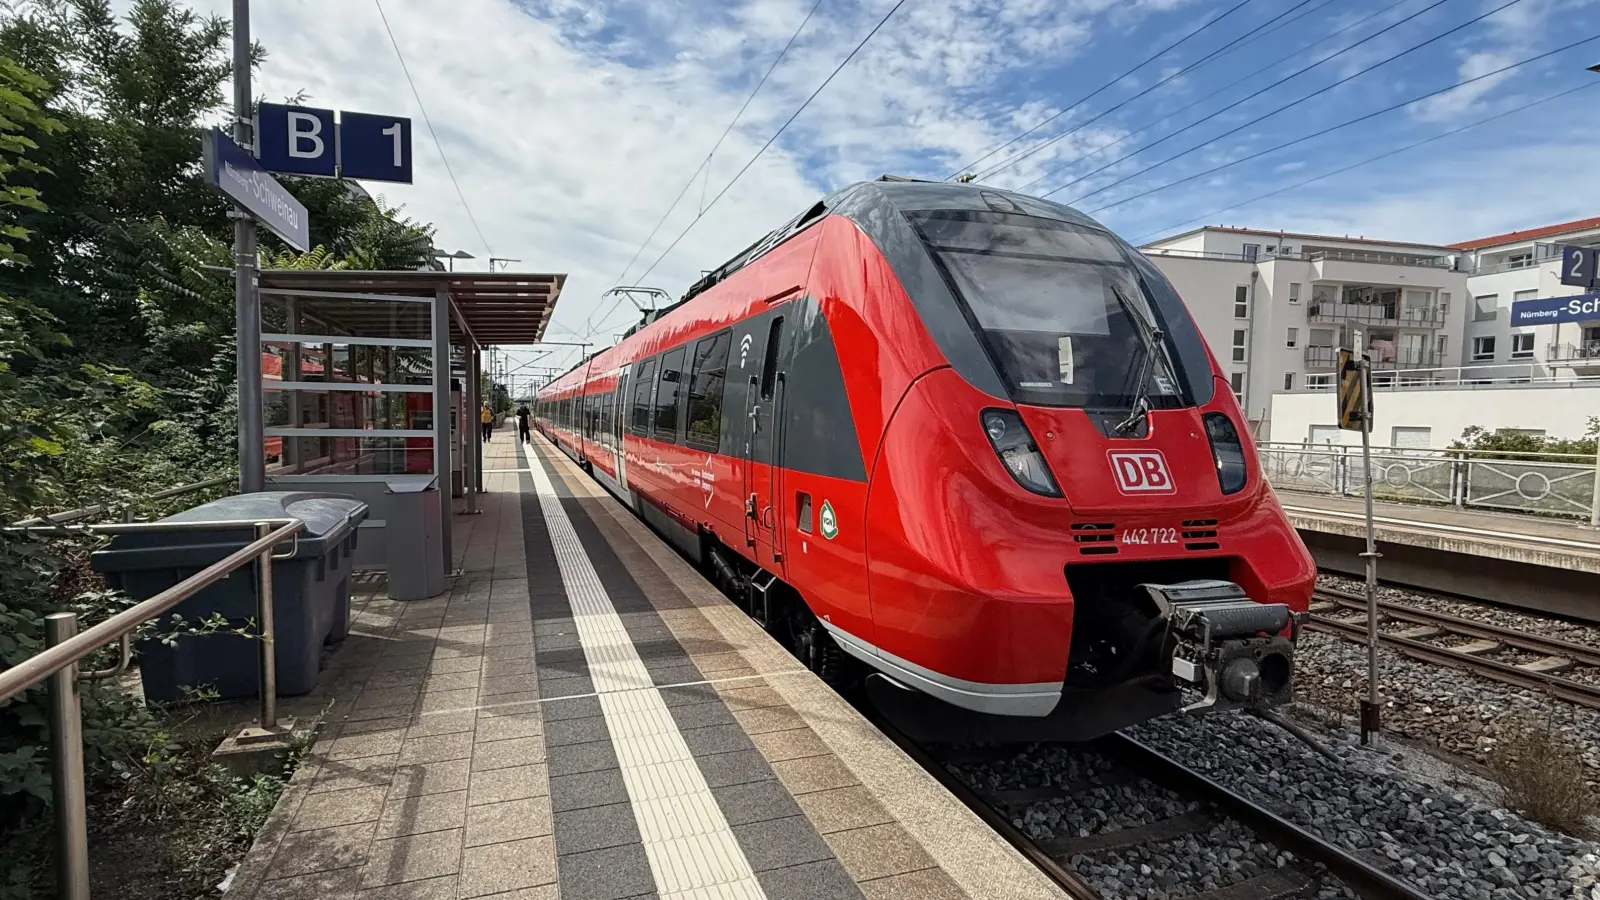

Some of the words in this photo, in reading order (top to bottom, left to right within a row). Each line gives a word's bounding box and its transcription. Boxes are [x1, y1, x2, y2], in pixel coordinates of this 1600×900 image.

[287, 111, 325, 159] B
[382, 122, 402, 167] 1
[1570, 250, 1583, 277] 2
[1116, 456, 1167, 487] DB
